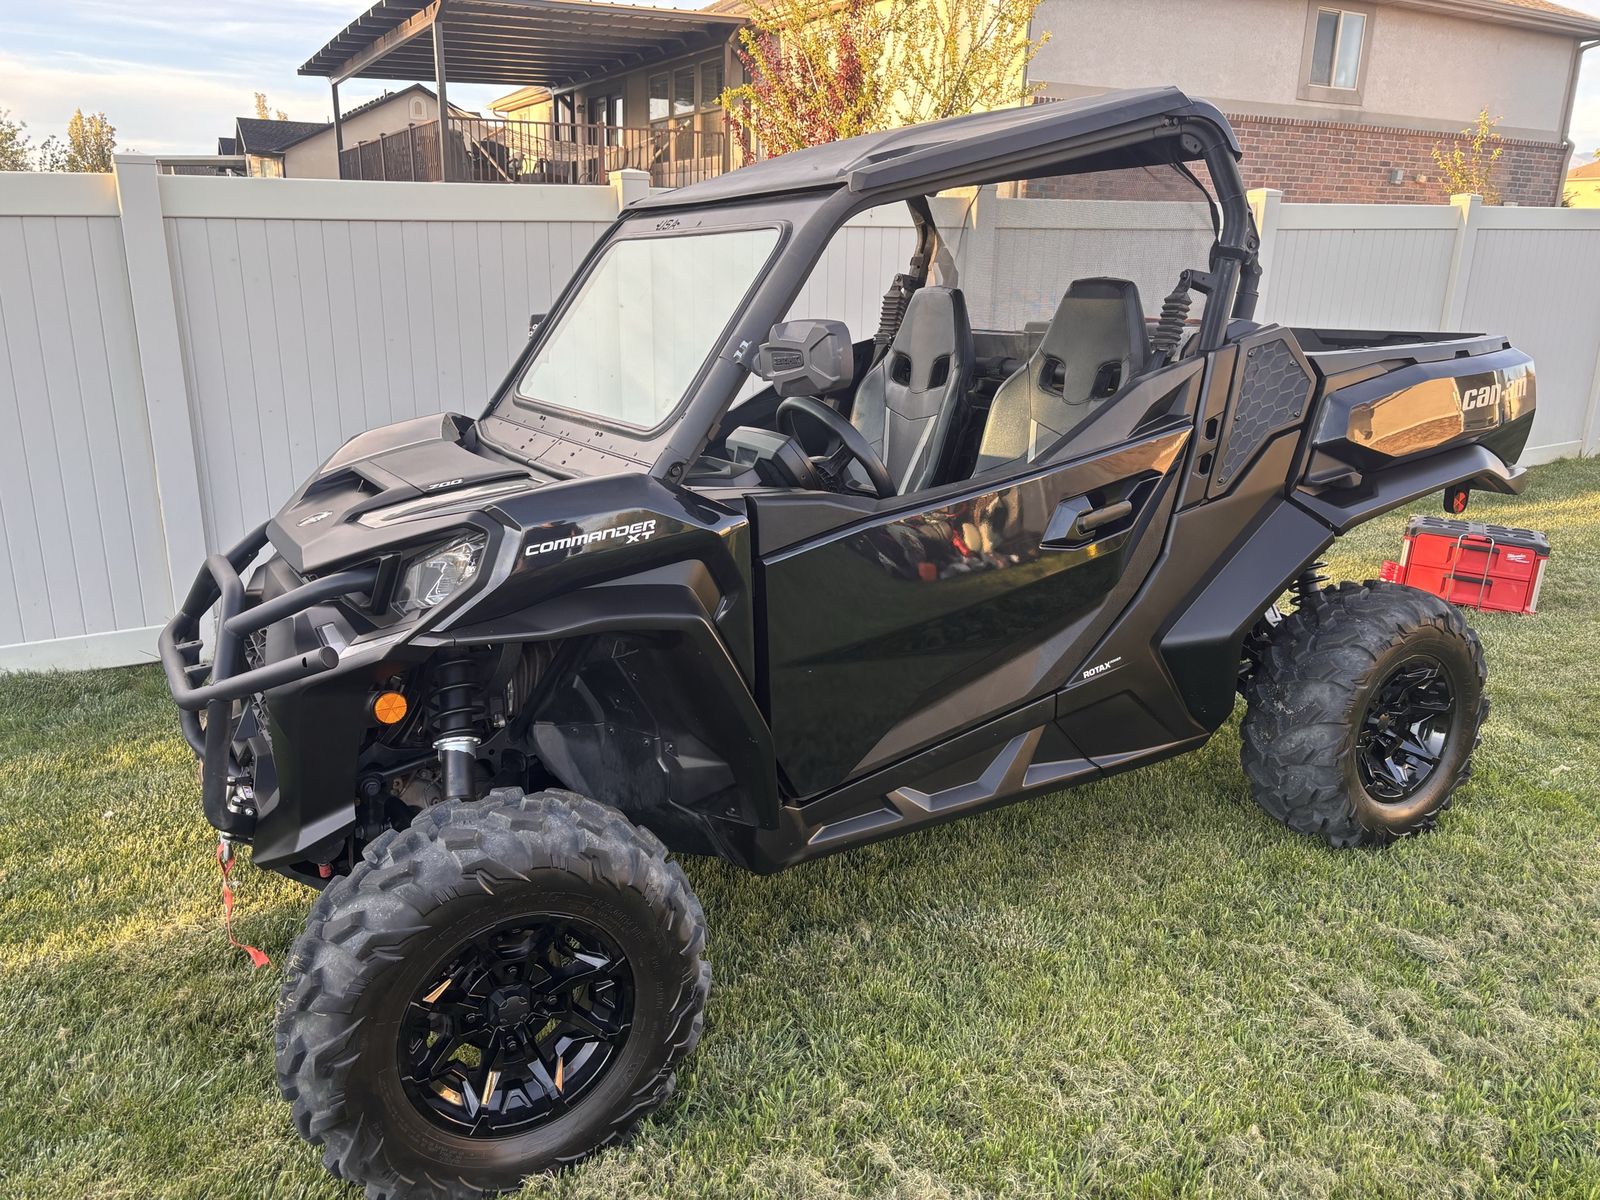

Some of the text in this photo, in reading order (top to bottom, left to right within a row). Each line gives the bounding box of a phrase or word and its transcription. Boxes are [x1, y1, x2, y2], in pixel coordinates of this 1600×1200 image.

[525, 519, 657, 557] COMMANDER
[626, 530, 656, 545] XT
[1083, 661, 1111, 679] ROTAX
